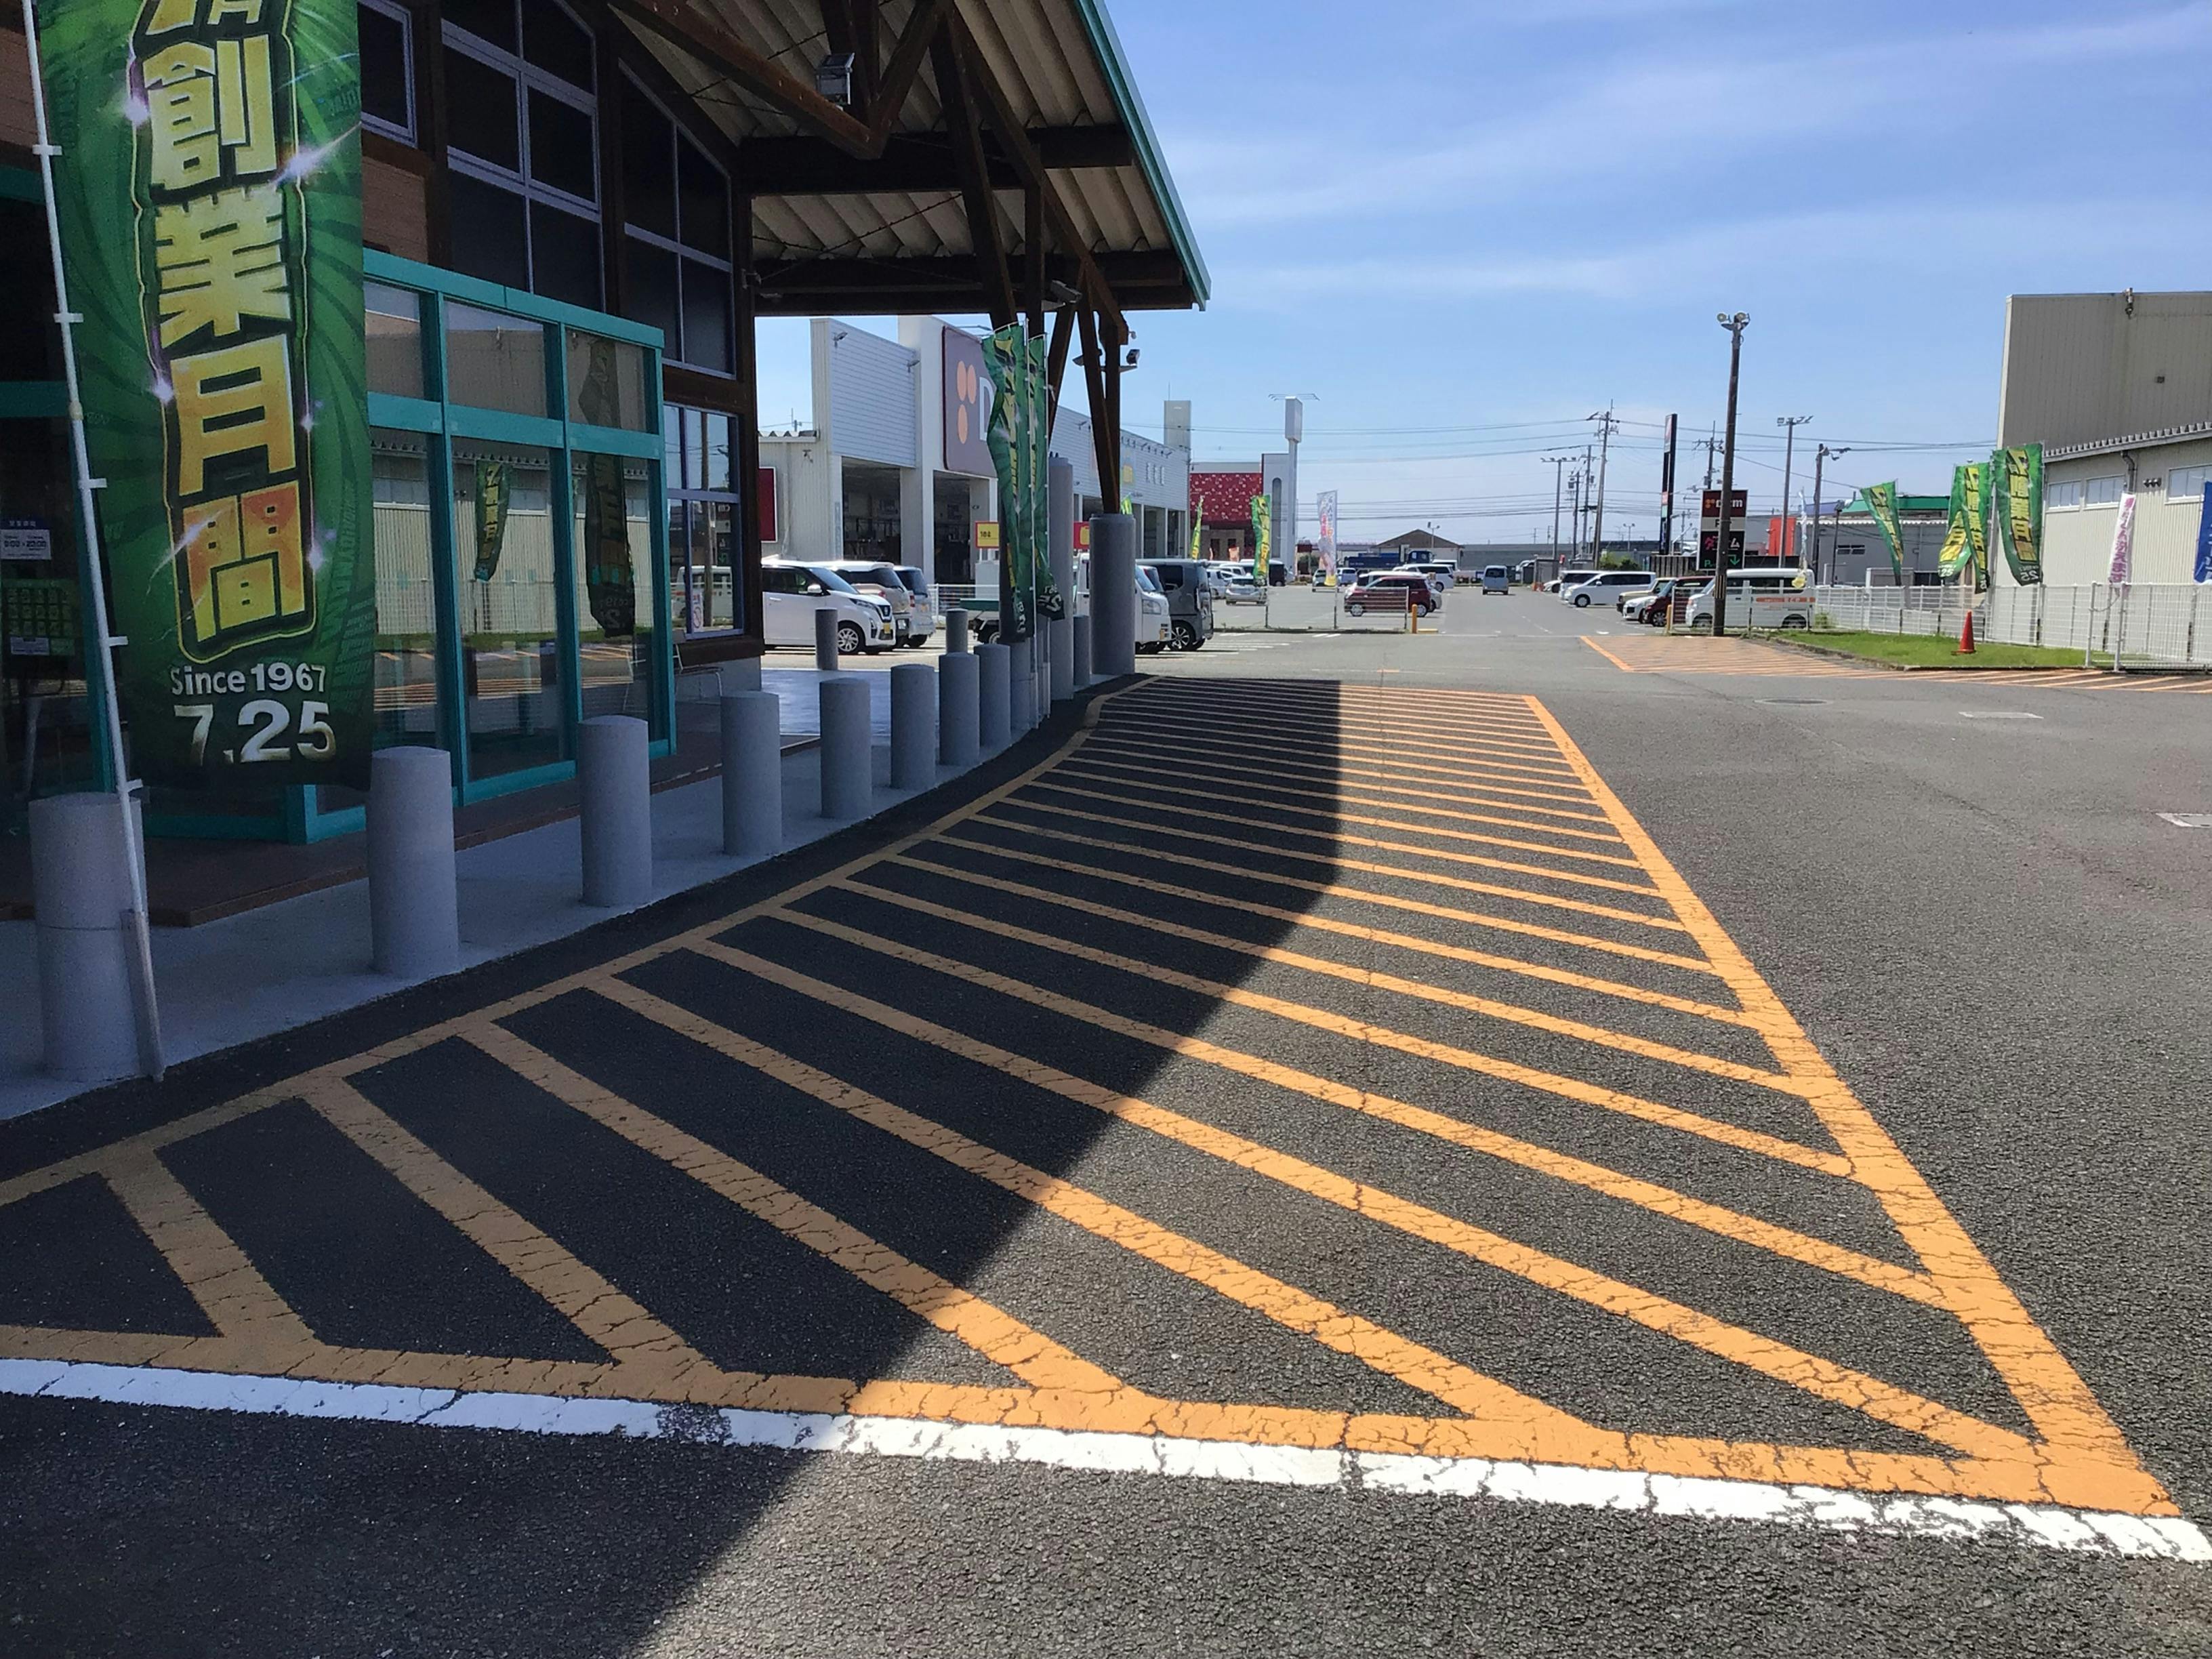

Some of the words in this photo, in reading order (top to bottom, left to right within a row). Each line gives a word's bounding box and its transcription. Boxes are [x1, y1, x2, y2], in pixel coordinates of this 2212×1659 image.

[143, 0, 306, 642] 創業月間
[170, 665, 247, 696] Since
[251, 661, 326, 693] 1967
[173, 699, 337, 766] 7.25
